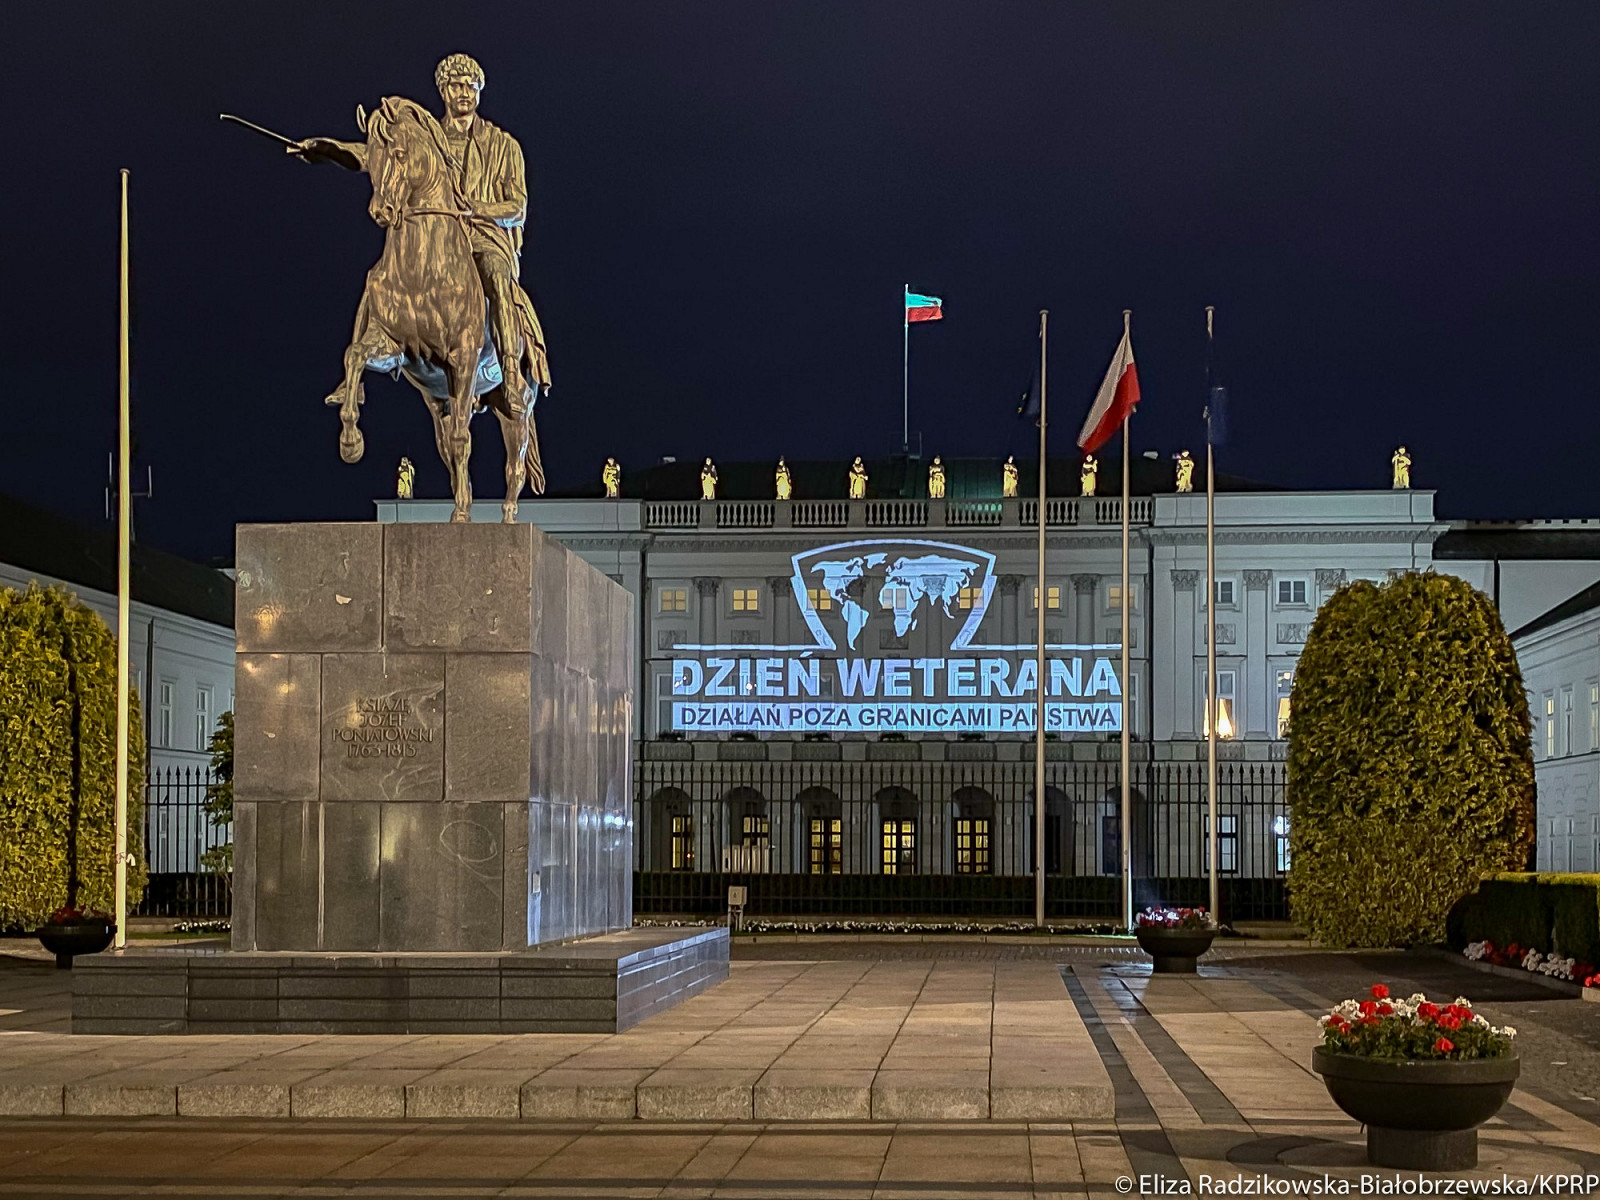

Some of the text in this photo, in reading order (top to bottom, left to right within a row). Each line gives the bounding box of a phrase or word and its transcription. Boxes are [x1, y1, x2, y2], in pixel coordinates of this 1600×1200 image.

[672, 651, 1122, 697] DZIEŃ WETERANA
[681, 703, 781, 726] DZIAŁAŃ
[788, 707, 852, 726] POZA
[858, 708, 992, 726] GRANICAMI
[332, 727, 434, 742] PONIATOWSKI
